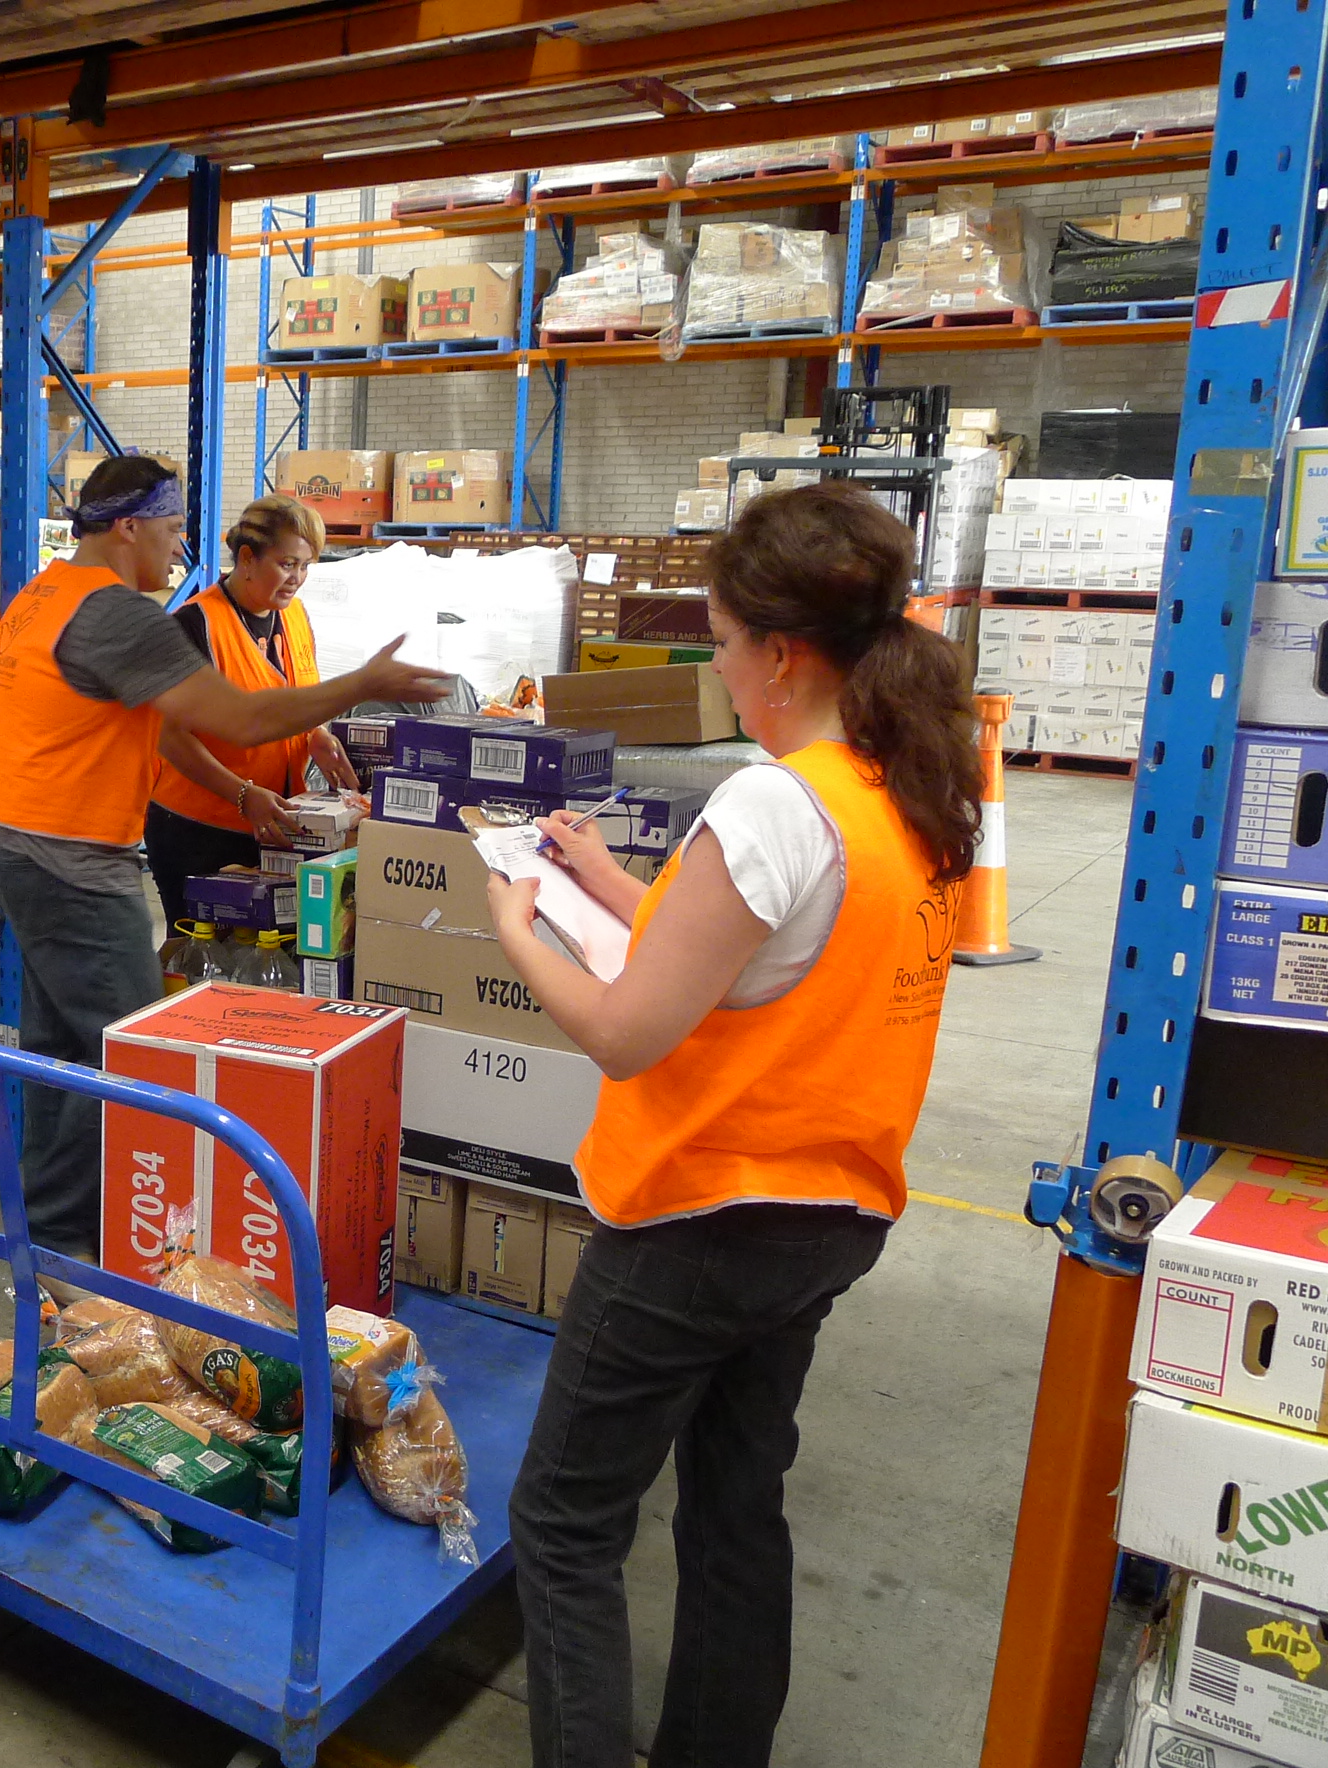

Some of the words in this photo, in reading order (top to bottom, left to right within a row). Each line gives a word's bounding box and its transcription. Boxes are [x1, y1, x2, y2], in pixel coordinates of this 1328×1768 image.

[296, 481, 341, 499] VISOBIN
[643, 630, 676, 641] HERBS
[677, 632, 698, 641] AND
[1260, 746, 1291, 756] COUNT
[1255, 759, 1262, 767] 6
[1254, 771, 1260, 779] 7
[1253, 783, 1259, 791] 8
[1252, 795, 1257, 803] 9
[1248, 807, 1259, 815] 10
[1246, 818, 1257, 827] 11
[1245, 831, 1256, 839] 12
[1244, 843, 1254, 851] 13
[1242, 855, 1252, 863] 15
[383, 856, 448, 892] C5025A
[1231, 910, 1271, 924] LARGE
[1226, 933, 1265, 946] CLASS
[1268, 936, 1274, 947] 1
[1281, 939, 1309, 948] GROWN
[1230, 976, 1261, 988] 13KG
[1232, 989, 1256, 1000] NET
[320, 1002, 385, 1018] 7034
[247, 1028, 290, 1039] CHIPS
[317, 1031, 345, 1039] CUT
[464, 1048, 527, 1083] 4120
[457, 1149, 472, 1159] LIME
[478, 1154, 498, 1164] BLACK
[498, 1158, 521, 1169] PEPPER
[471, 1145, 486, 1154] DELI
[486, 1149, 507, 1159] STYLE
[447, 1153, 467, 1164] SWEET
[467, 1157, 486, 1167] CHILLI
[492, 1163, 509, 1173] SOUR
[509, 1166, 531, 1178] CREAM
[459, 1162, 481, 1173] HONEY
[481, 1166, 503, 1178] BAKED
[503, 1170, 518, 1180] HAM
[130, 1150, 166, 1258] C7034
[241, 1170, 279, 1281] C7034
[378, 1232, 393, 1296] 7034
[1158, 1258, 1190, 1274] GROWN
[1191, 1264, 1210, 1278] AND
[1212, 1269, 1245, 1285] PACKED
[1246, 1276, 1258, 1288] BY
[1166, 1286, 1219, 1306] COUNT
[1287, 1280, 1321, 1299] RED
[1312, 1320, 1328, 1334] RIV
[1292, 1334, 1327, 1352] CADEL
[203, 1352, 234, 1379] LGA'S
[1310, 1355, 1326, 1368] SO
[1151, 1366, 1216, 1391] ROCKMELONS
[1278, 1402, 1320, 1424] PRODU
[132, 1413, 161, 1434] Mixed
[138, 1421, 165, 1437] Grain
[1234, 1479, 1328, 1556] LOWE
[1215, 1551, 1295, 1587] NORTH
[1260, 1629, 1313, 1658] MP
[1243, 1685, 1255, 1694] 03
[1185, 1708, 1198, 1719] IN
[1201, 1715, 1262, 1743] CLUSTERS
[1196, 1704, 1212, 1716] EX
[1214, 1711, 1253, 1731] LARGE
